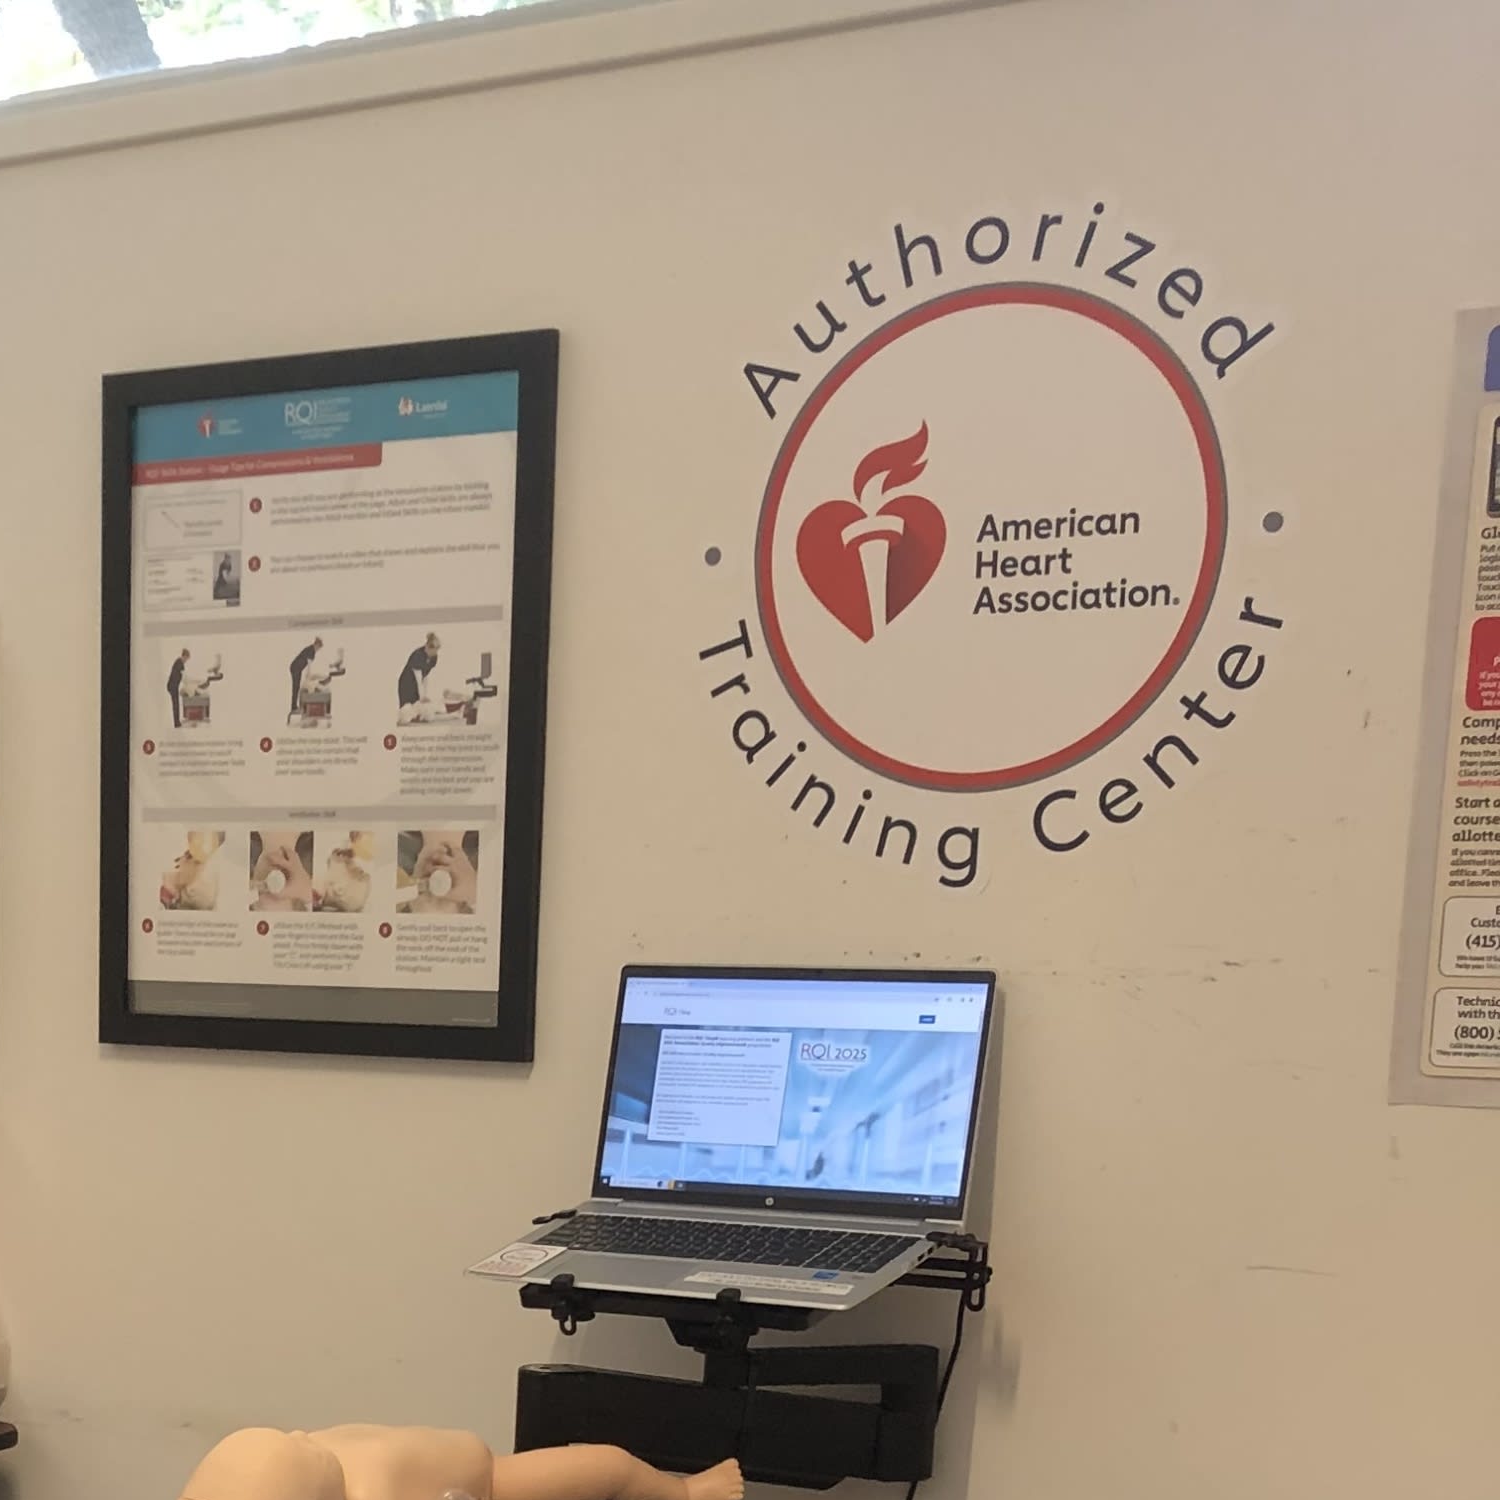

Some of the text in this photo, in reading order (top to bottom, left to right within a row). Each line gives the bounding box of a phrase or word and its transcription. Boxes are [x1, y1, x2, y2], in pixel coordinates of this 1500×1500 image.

[743, 202, 1274, 419] Authorized
[976, 508, 1140, 543] American
[975, 548, 1073, 579] Heart
[699, 597, 1283, 888] Training Center
[1455, 797, 1490, 808] Start
[1458, 1009, 1486, 1018] with
[1454, 1025, 1495, 1041] (800)
[801, 1043, 867, 1060] RQI 2025
